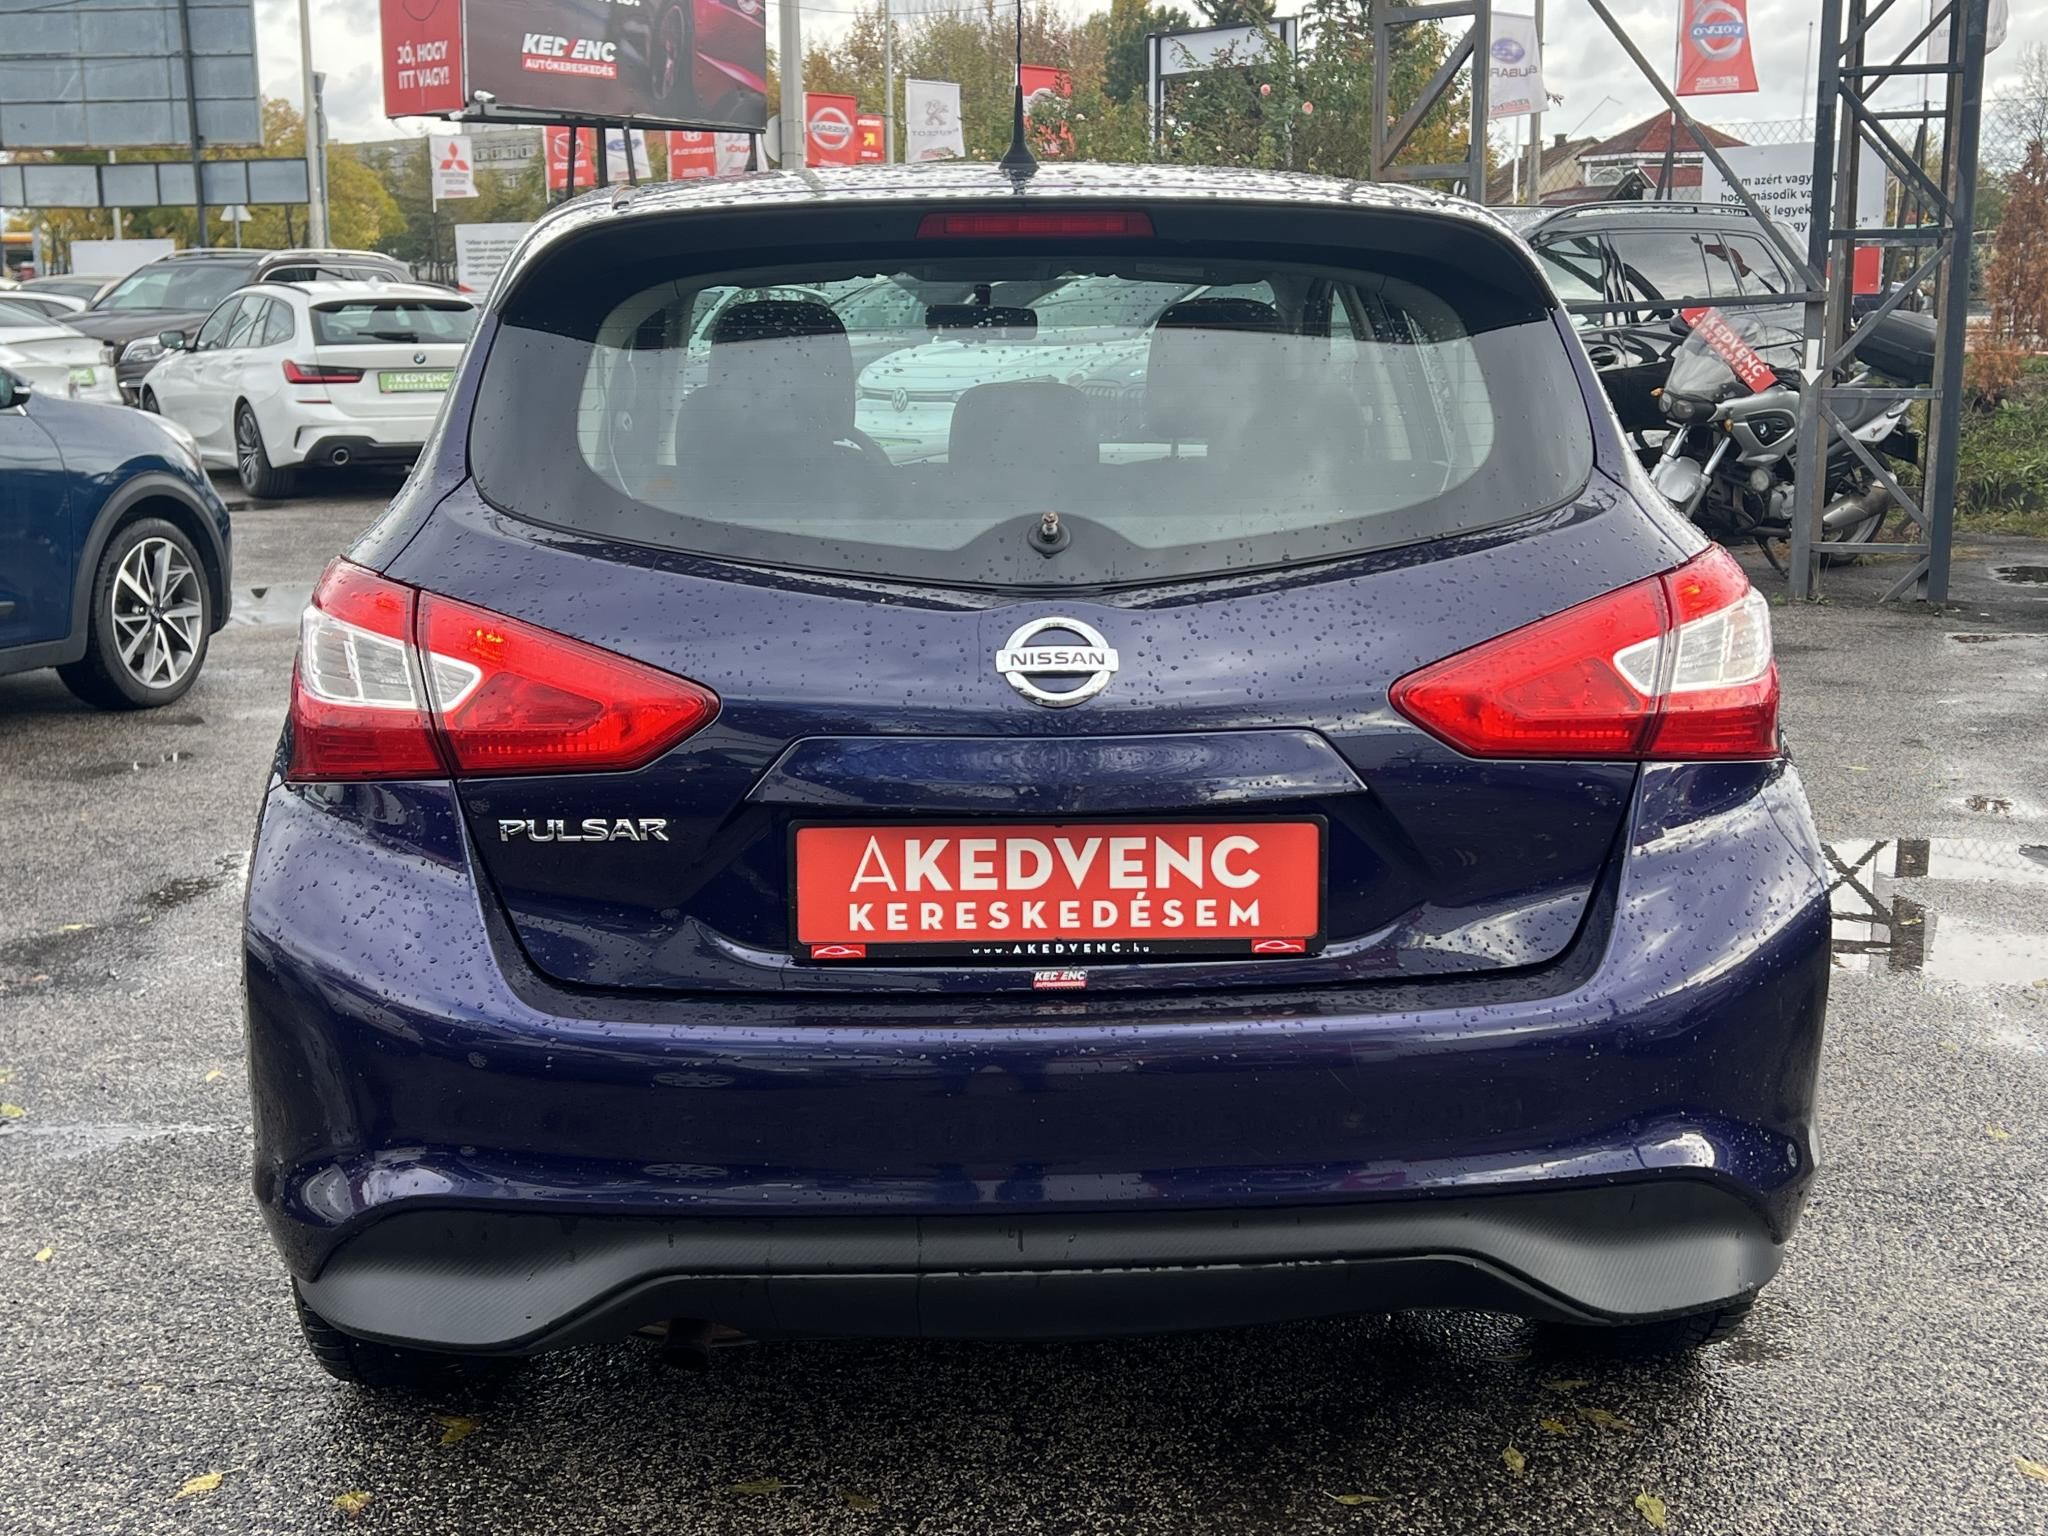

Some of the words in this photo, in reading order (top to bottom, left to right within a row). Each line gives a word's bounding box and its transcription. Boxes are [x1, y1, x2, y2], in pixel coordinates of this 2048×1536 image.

[397, 40, 416, 66] JÓ,
[417, 40, 449, 62] HOGY
[398, 71, 415, 89] ITT
[417, 66, 450, 87] VAGY!
[1754, 174, 1783, 186] azért
[1751, 188, 1797, 201] második
[1010, 651, 1105, 666] NISSAN
[498, 818, 669, 842] PULSAR
[850, 891, 1261, 931] KERESKEDÉSEM
